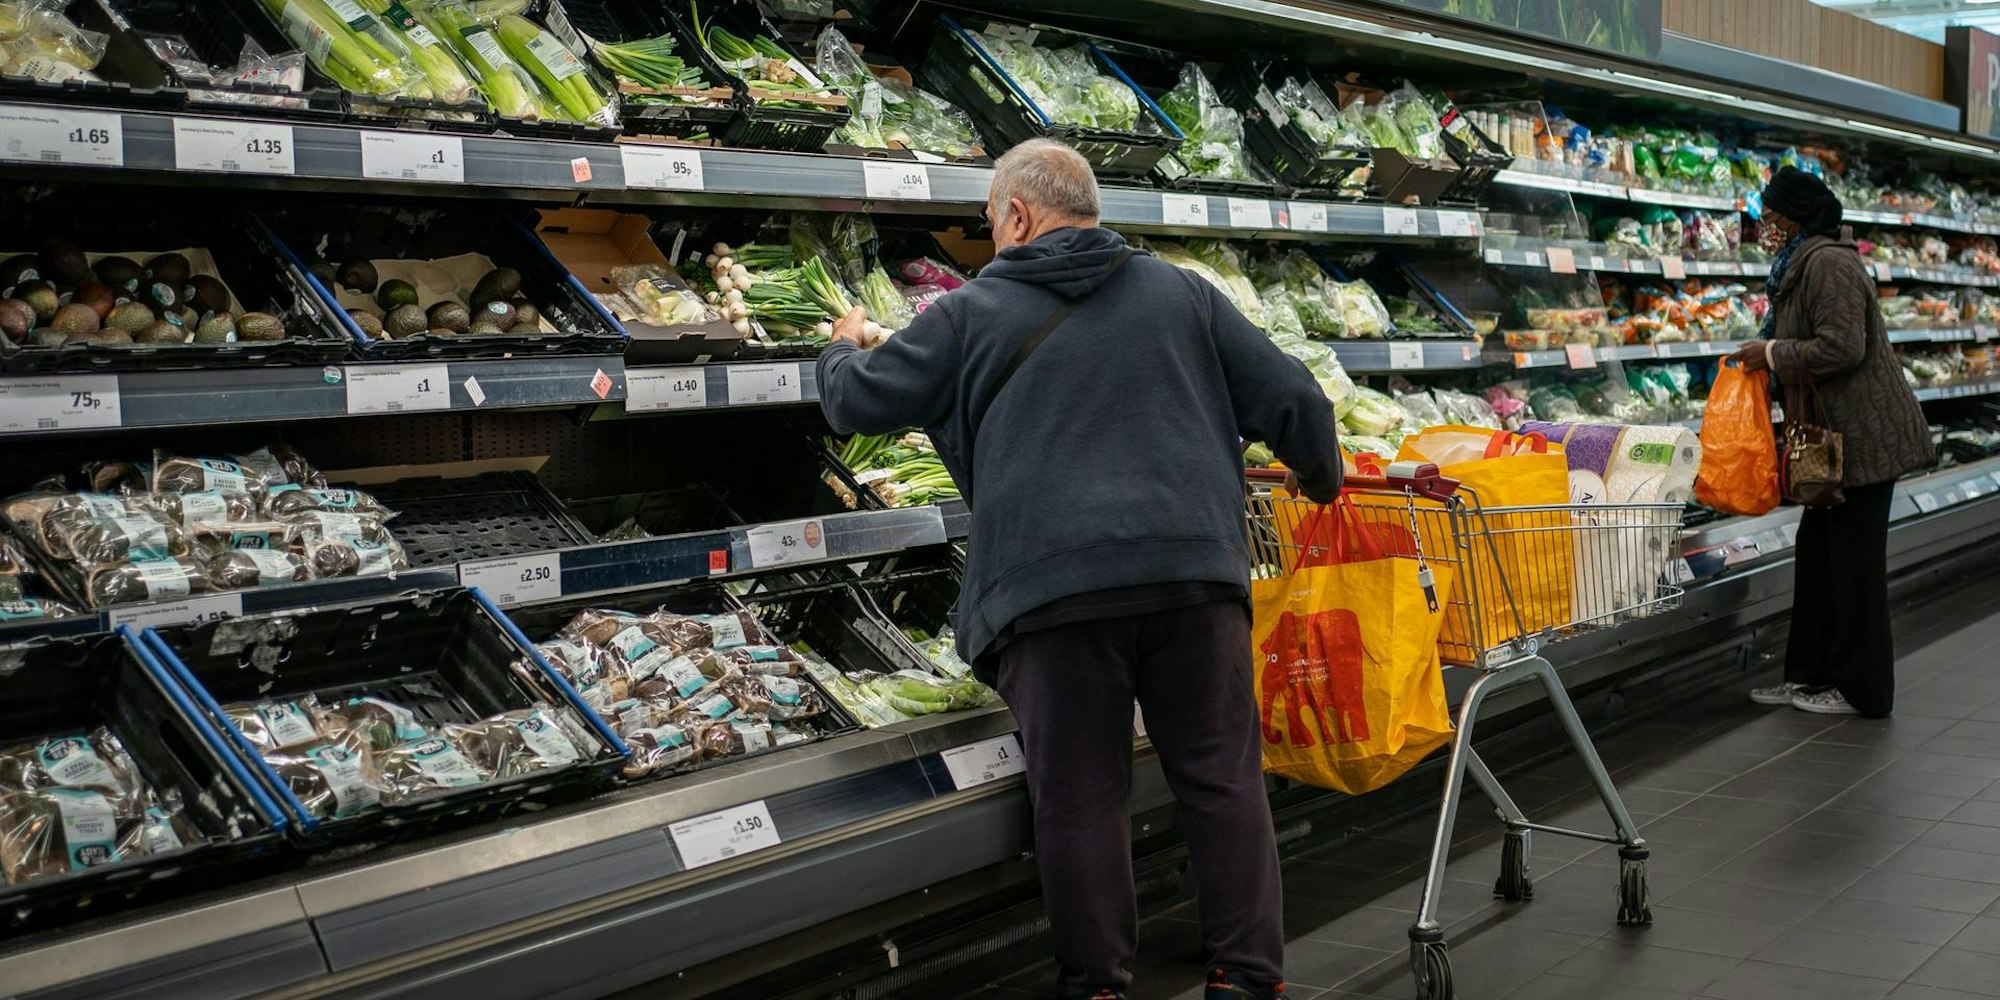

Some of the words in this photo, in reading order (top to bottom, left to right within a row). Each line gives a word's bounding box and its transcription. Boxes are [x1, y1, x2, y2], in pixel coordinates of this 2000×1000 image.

[1988, 53, 2000, 108] P
[70, 128, 109, 144] £1.65
[247, 139, 282, 154] £1.35
[432, 150, 444, 164] £1
[673, 161, 692, 176] 95p
[418, 379, 430, 392] £1
[673, 380, 697, 392] £1.40
[777, 375, 788, 387] £1
[70, 392, 100, 409] 75p
[781, 536, 797, 548] 43p
[520, 566, 550, 582] £2.50
[998, 746, 1008, 760] £1
[733, 816, 762, 834] £1.50
